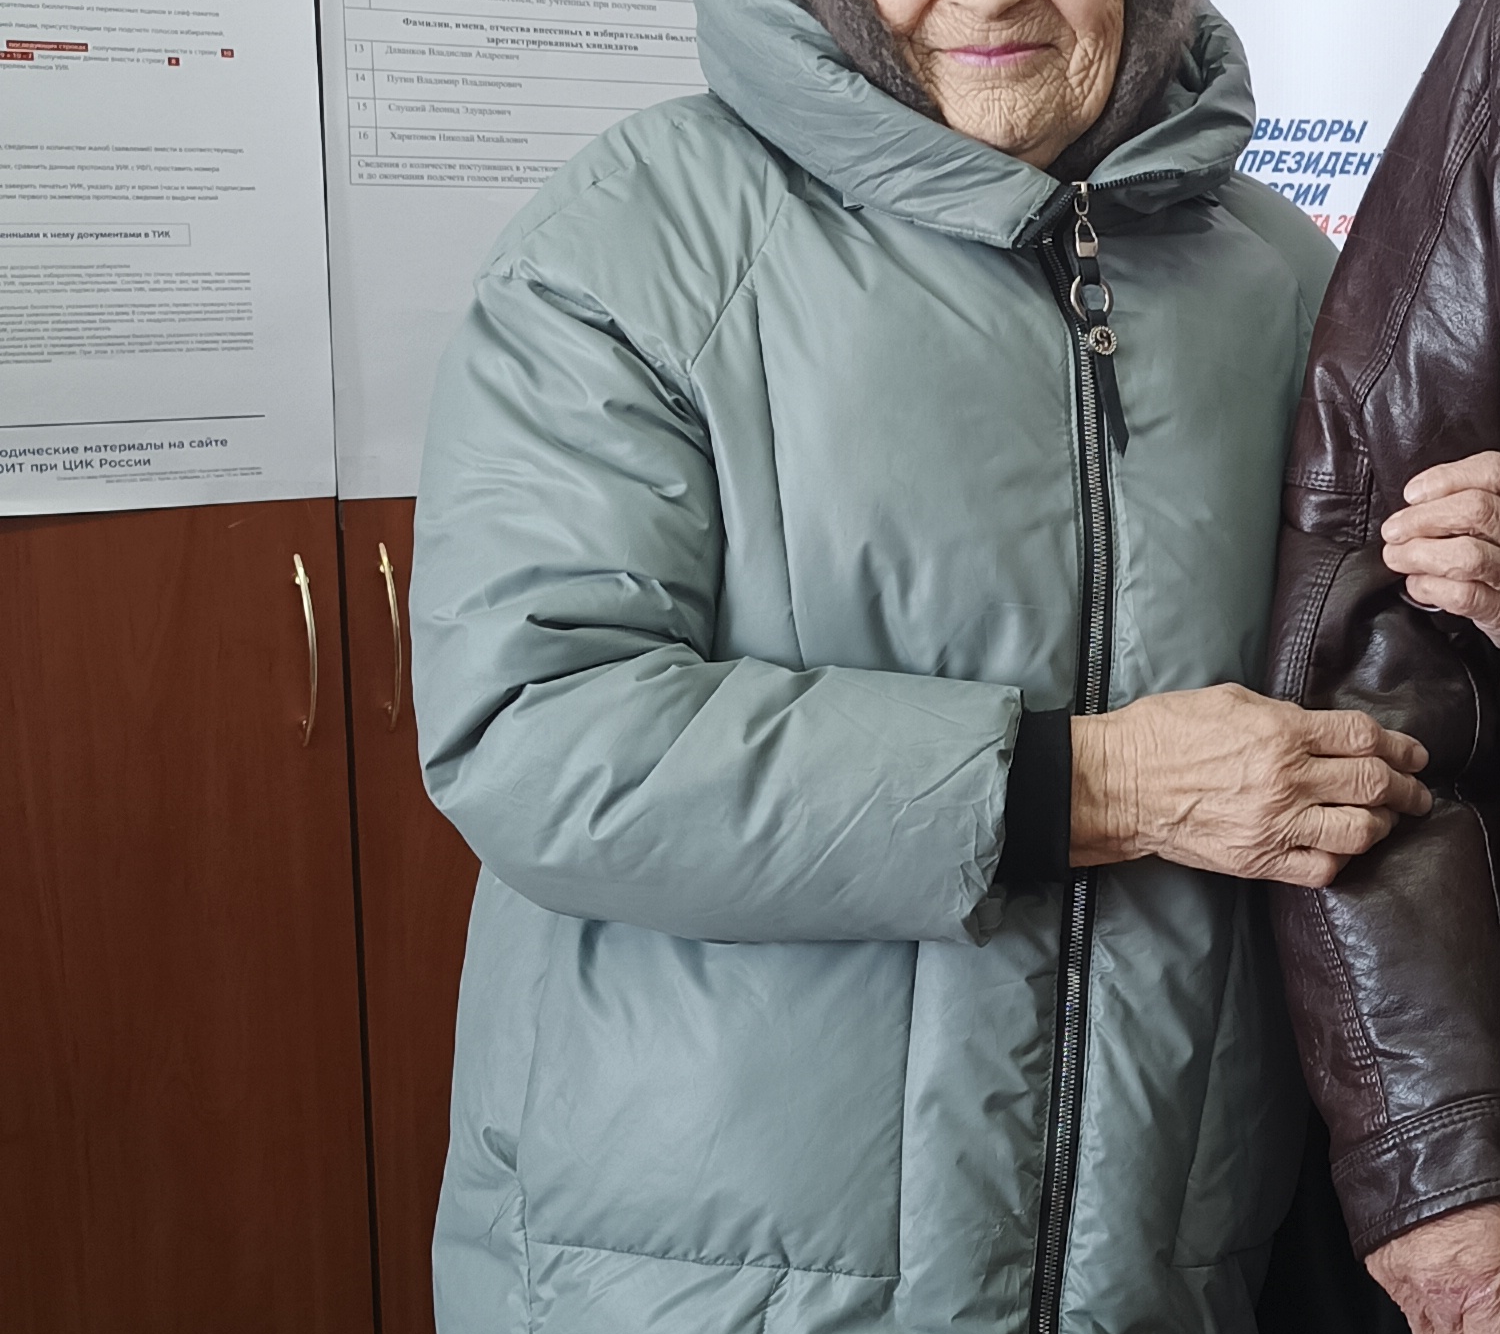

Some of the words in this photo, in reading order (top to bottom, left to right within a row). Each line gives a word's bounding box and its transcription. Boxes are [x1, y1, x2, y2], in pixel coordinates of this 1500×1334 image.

[402, 17, 453, 31] Фамилии,
[490, 24, 530, 33] отчества
[354, 44, 364, 53] 13
[355, 74, 365, 82] 14
[386, 74, 414, 86] Путин
[416, 75, 460, 89] Владимир
[462, 77, 522, 91] Владимирович
[357, 102, 367, 111] 15
[358, 131, 368, 140] 16
[438, 133, 474, 143] Николай
[476, 134, 528, 144] Михайлович
[1252, 118, 1368, 143] ВЫБОРЫ
[1238, 150, 1384, 178] ПРЕЗИДЕН
[50, 232, 75, 241] нему
[77, 231, 142, 241] документами
[151, 230, 171, 238] ТИК
[84, 440, 164, 454] материалы
[168, 439, 184, 449] на
[189, 437, 228, 449] сайте
[31, 463, 58, 474] при
[63, 459, 94, 472] ЦИК
[100, 457, 151, 468] России
